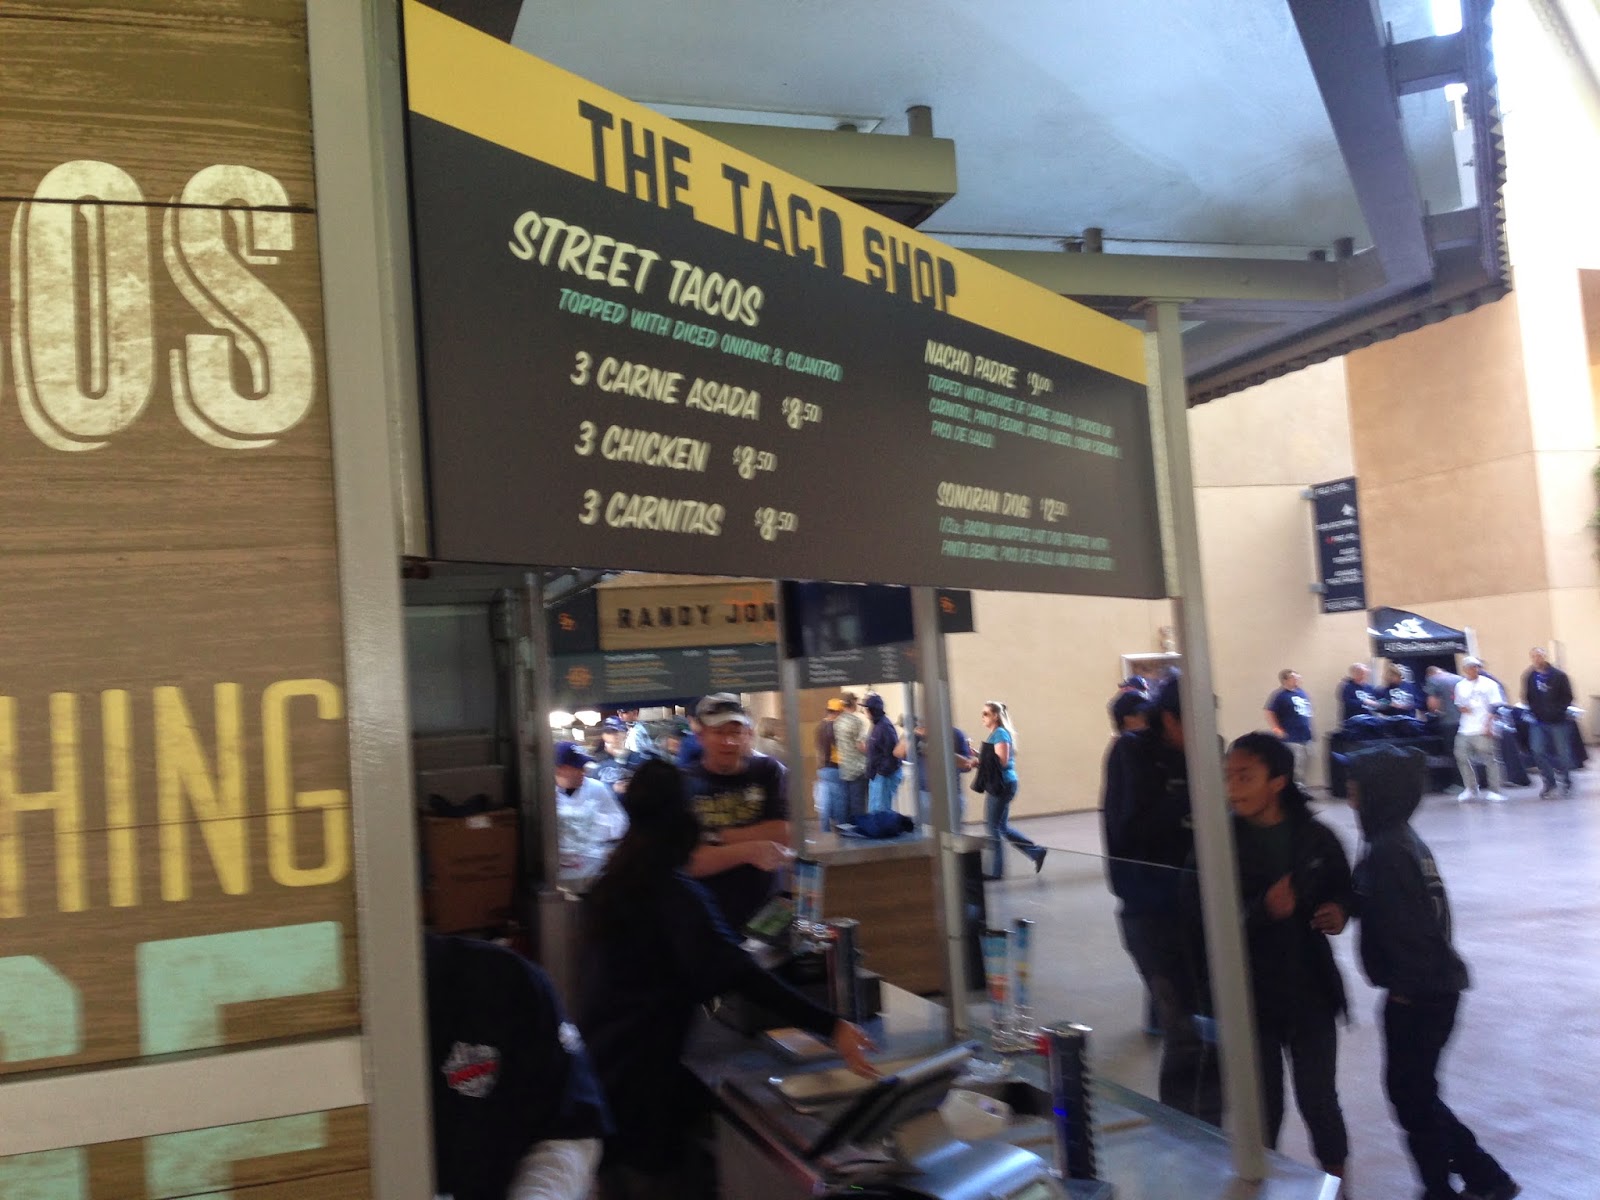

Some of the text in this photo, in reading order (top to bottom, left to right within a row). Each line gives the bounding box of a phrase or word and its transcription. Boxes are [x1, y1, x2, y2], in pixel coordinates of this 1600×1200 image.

[578, 99, 957, 313] THE TACO SHOP
[508, 211, 765, 327] STREET TACOS
[560, 288, 844, 382] TOPPED WITH DICED ONIONS & CILANTRO
[570, 351, 593, 386] 3
[596, 357, 685, 404] CARNE
[685, 378, 762, 421] ASADA
[924, 339, 974, 376] NACHO
[973, 355, 1019, 390] PADRE
[928, 374, 963, 398] TOPPED
[575, 421, 597, 456] 3
[600, 425, 712, 472] CHICKEN
[579, 489, 601, 525] 3
[604, 492, 727, 537] CARNITAS
[936, 481, 1001, 514] SONORAN
[1002, 492, 1032, 518] DOG
[617, 604, 709, 629] RANDY
